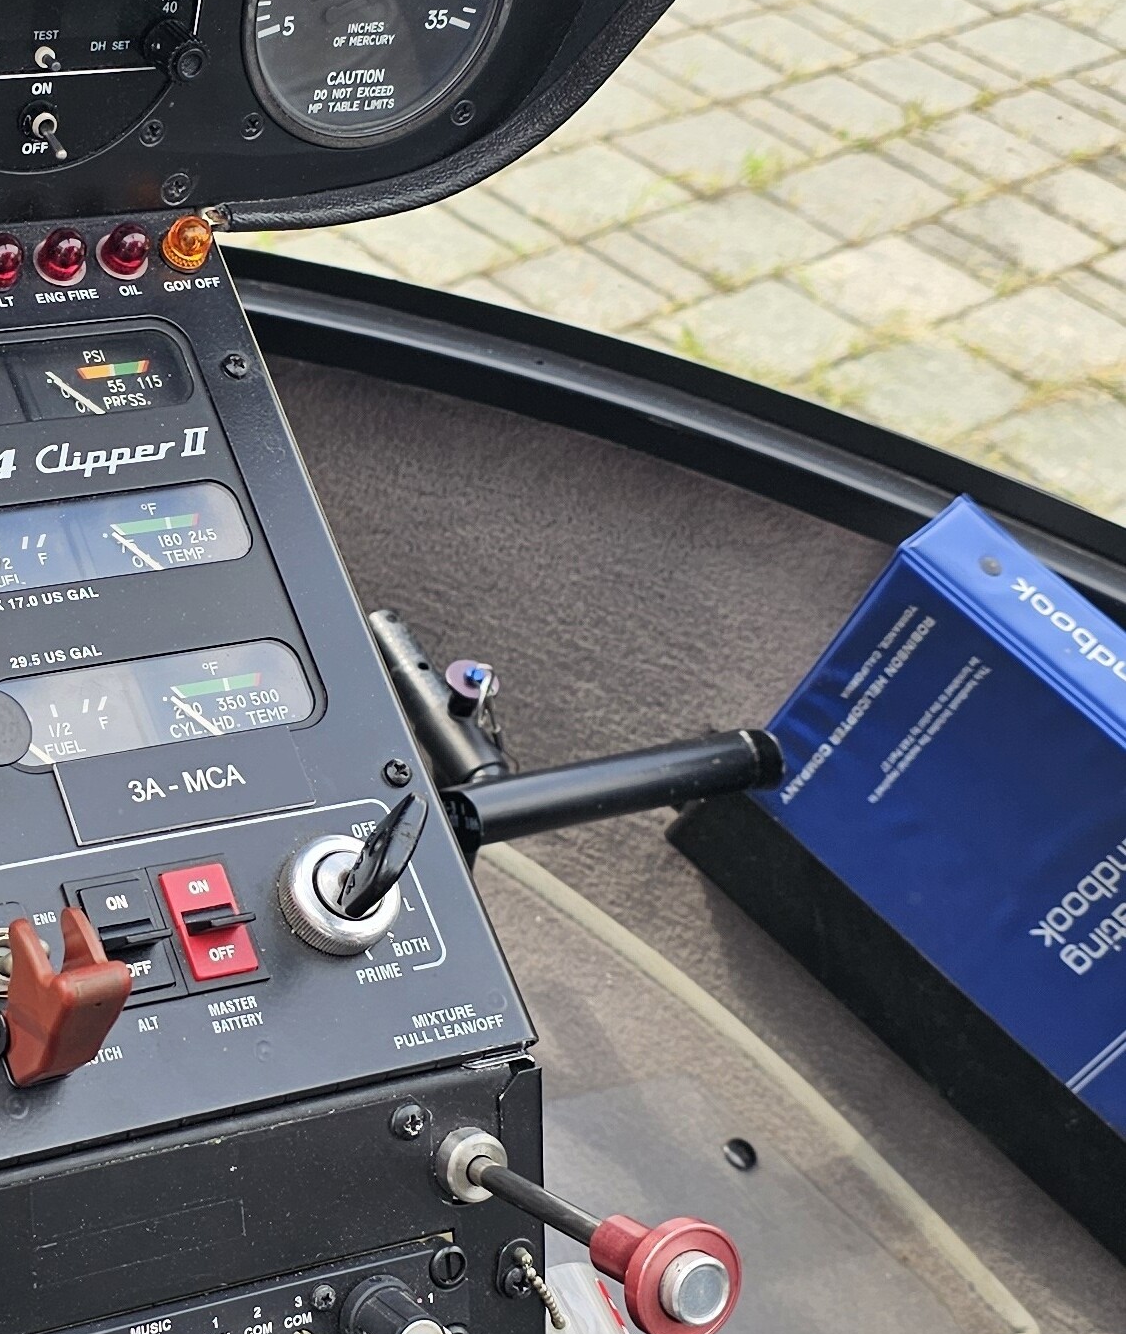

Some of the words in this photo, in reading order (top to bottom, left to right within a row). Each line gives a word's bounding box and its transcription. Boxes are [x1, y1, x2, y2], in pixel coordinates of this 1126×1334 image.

[33, 30, 59, 41] TEST
[347, 22, 385, 34] INCHES
[90, 41, 106, 52] DH
[112, 40, 131, 51] SET
[333, 36, 346, 47] OF
[349, 34, 395, 47] MERCURY
[327, 69, 385, 86] CAUTION
[31, 82, 53, 95] ON
[313, 88, 328, 100] DO
[332, 87, 352, 99] NOT
[357, 85, 394, 98] EXCEED
[308, 102, 322, 114] MP
[328, 100, 360, 113] TABLE
[364, 98, 395, 111] LIMITS
[22, 142, 49, 154] OFF
[119, 285, 143, 297] OIL
[163, 279, 194, 293] GOV
[196, 277, 221, 289] OFF
[35, 292, 69, 304] ENG
[71, 288, 99, 301] FIRE
[83, 350, 106, 363] PSI
[137, 375, 162, 391] 115
[35, 441, 175, 477] Clipper
[7, 593, 40, 609] 17.0
[41, 591, 64, 605] US
[66, 585, 99, 601] GAL
[882, 614, 937, 677] ROBINSON
[9, 651, 42, 669] 29.5
[43, 647, 68, 663] US
[69, 644, 102, 660] GAL
[826, 674, 889, 747] HELICOPTER
[778, 742, 833, 805] COMPANY
[187, 879, 209, 895] ON
[33, 911, 57, 925] ENG
[208, 945, 235, 962] OFF
[392, 936, 431, 958] BOTH
[355, 963, 403, 985] PRIME
[208, 996, 258, 1017] MASTER
[211, 1012, 264, 1034] BATTERY
[412, 1003, 476, 1028] MIXTURE
[394, 1029, 433, 1049] PULL
[434, 1015, 504, 1042] LEAN/OFF
[283, 1312, 313, 1328] COM
